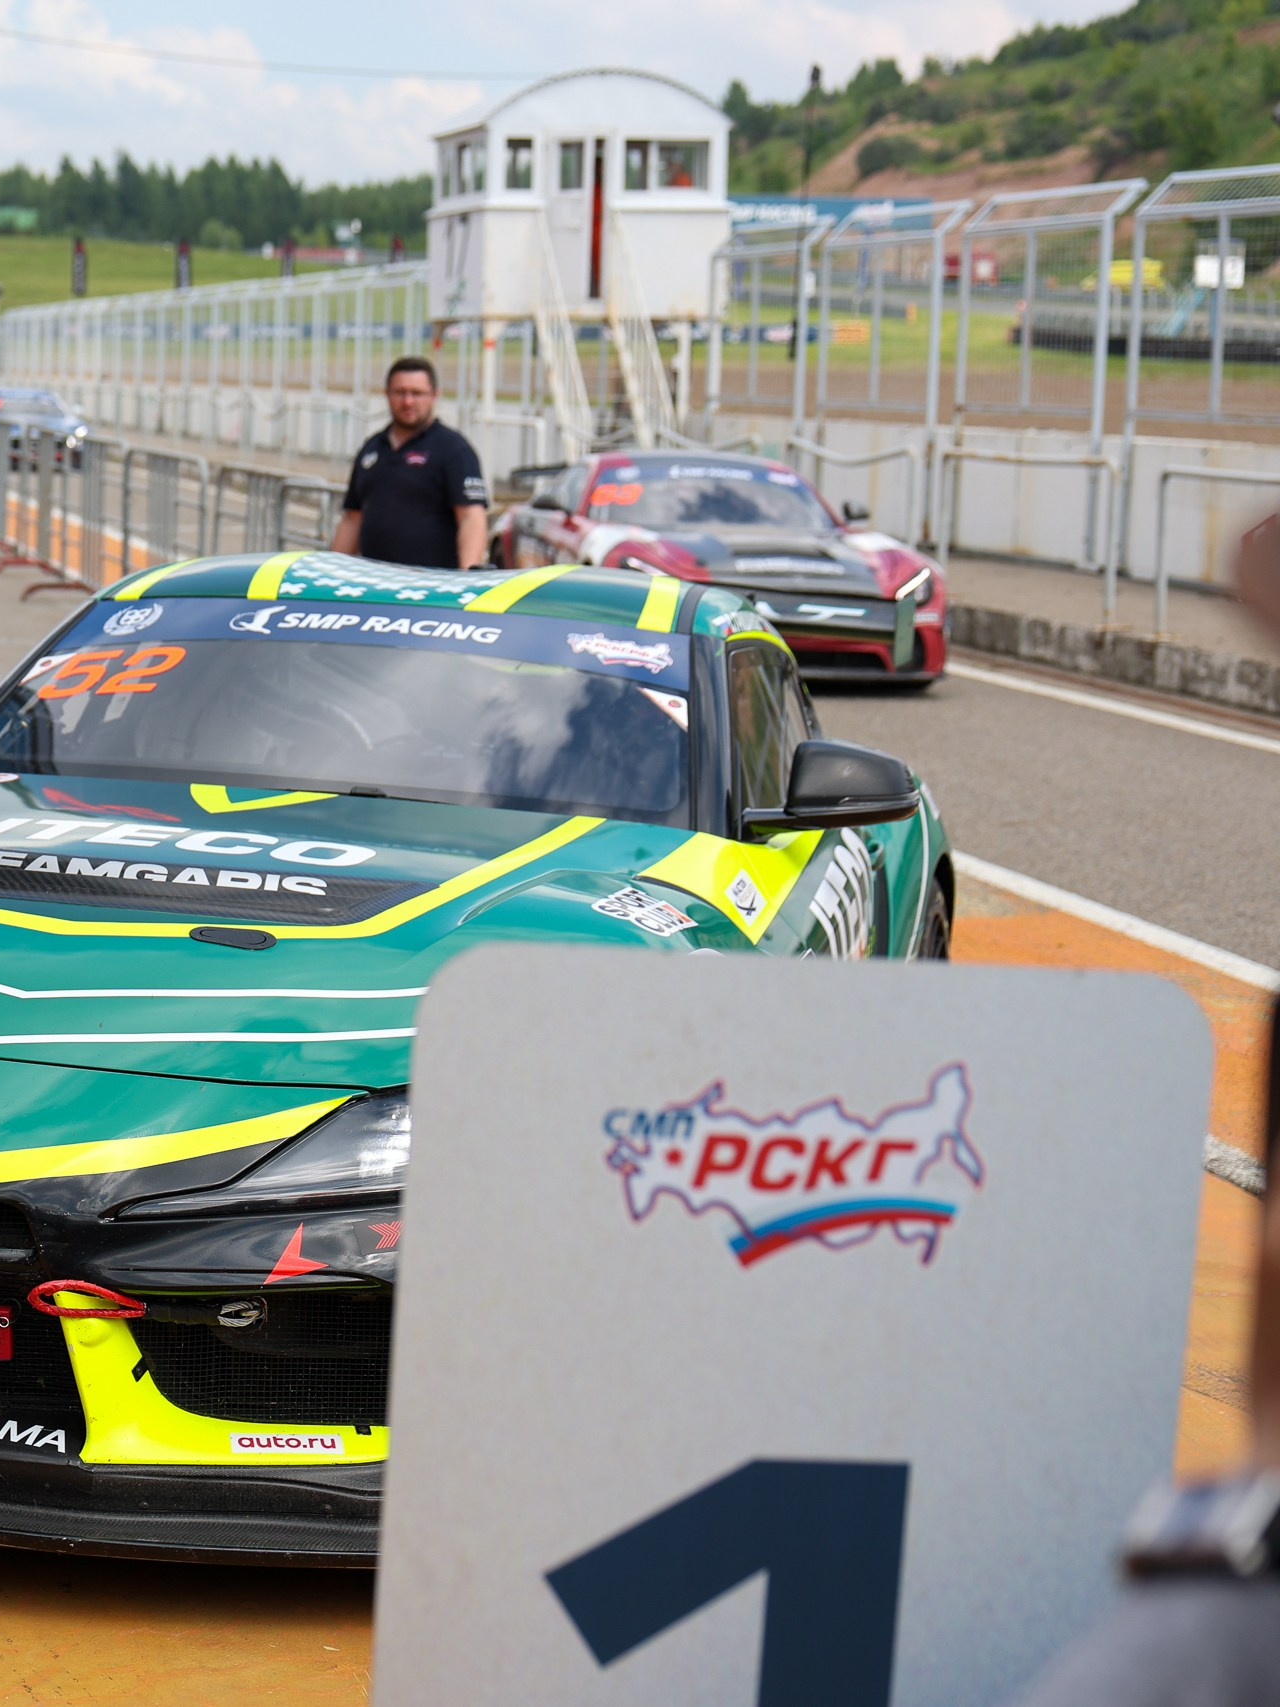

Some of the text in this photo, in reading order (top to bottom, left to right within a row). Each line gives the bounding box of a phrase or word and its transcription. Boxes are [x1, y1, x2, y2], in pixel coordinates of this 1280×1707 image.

[277, 612, 502, 644] SMP RACING
[37, 646, 187, 700] 52
[602, 1107, 696, 1138] СМП
[691, 1134, 919, 1192] РСКГ
[237, 1435, 338, 1450] auto.ru
[543, 1457, 912, 1707] 1
